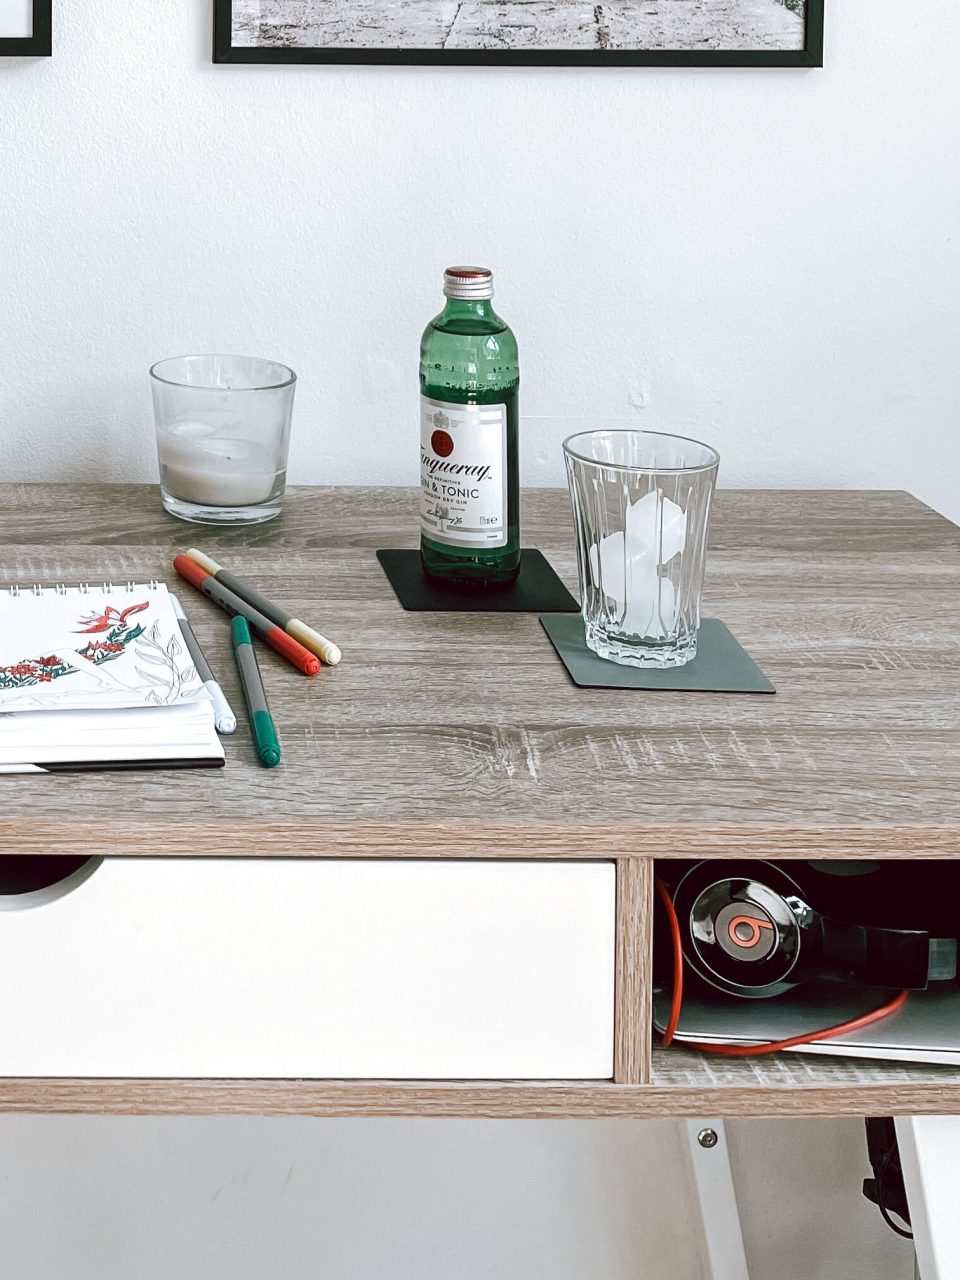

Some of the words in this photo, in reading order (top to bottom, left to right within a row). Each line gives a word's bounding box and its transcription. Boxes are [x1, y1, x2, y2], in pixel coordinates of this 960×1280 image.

[421, 444, 491, 482] nqueray
[432, 482, 439, 492] &
[441, 484, 480, 499] TONIC
